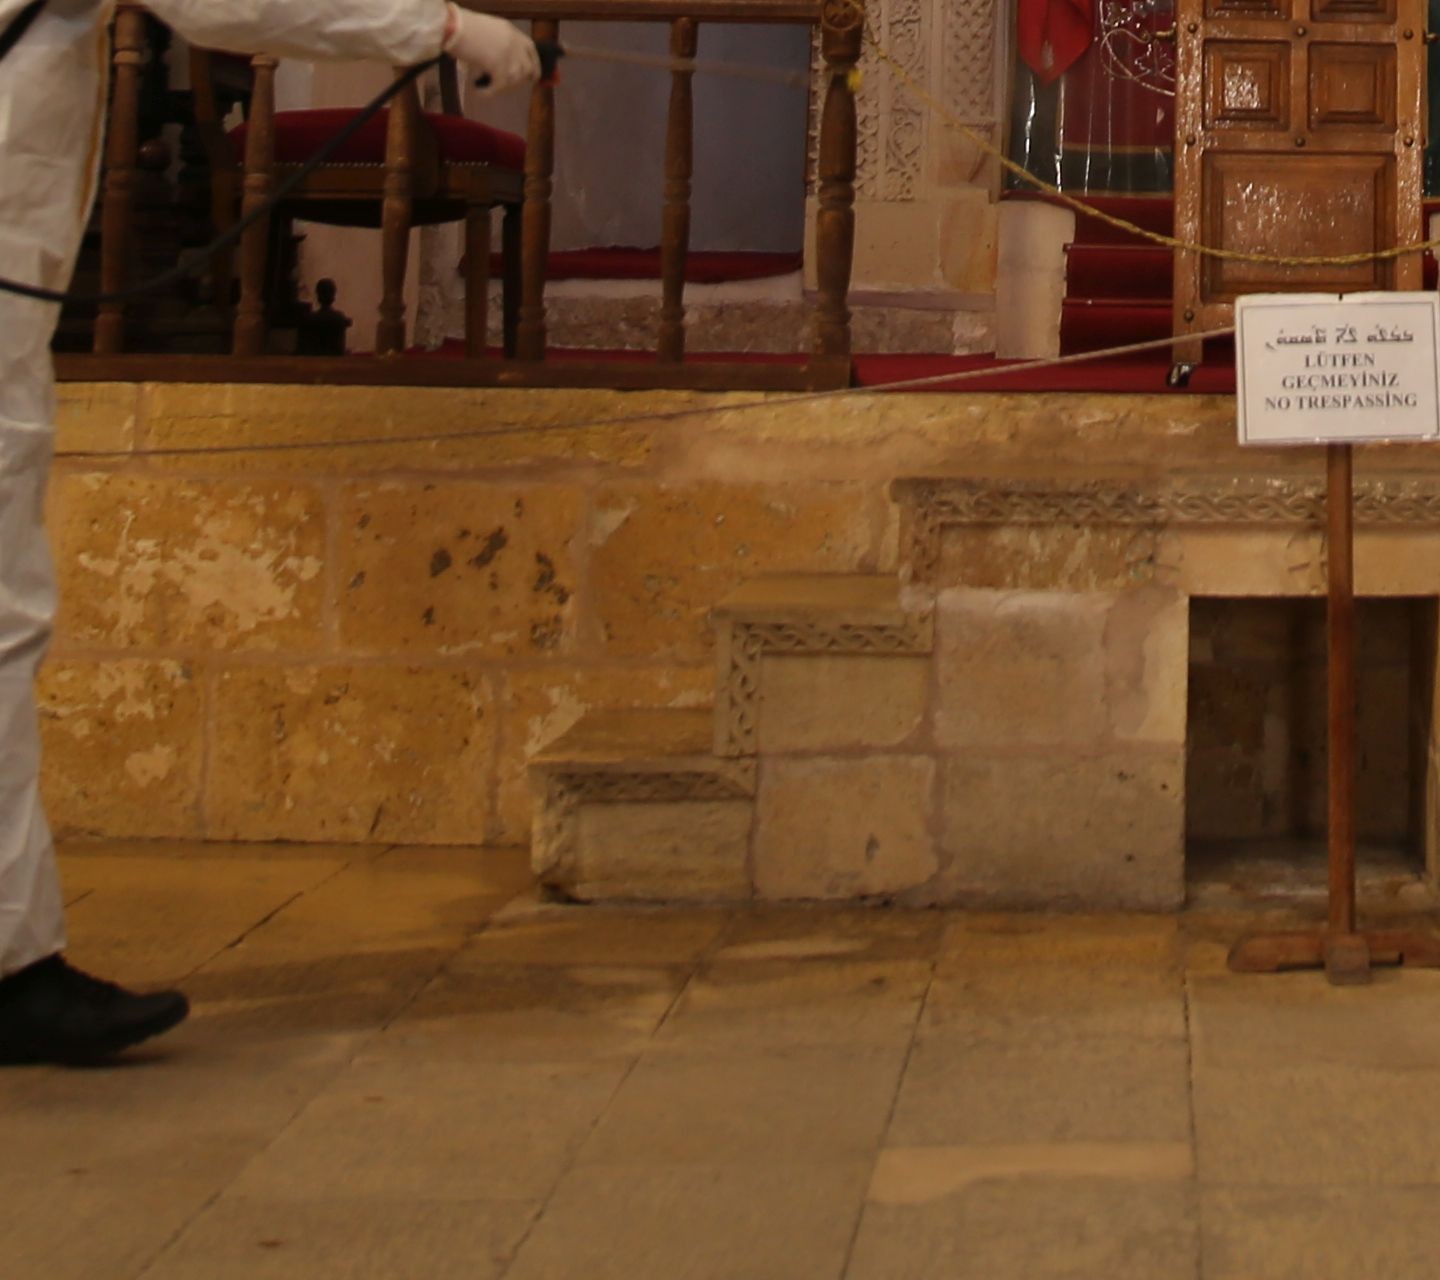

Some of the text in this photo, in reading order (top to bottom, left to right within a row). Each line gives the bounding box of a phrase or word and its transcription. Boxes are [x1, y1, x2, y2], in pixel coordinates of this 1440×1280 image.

[1305, 351, 1375, 368] LÜTFEN
[1281, 370, 1400, 391] GEÇMEYİNİZ
[1264, 396, 1291, 411] NO
